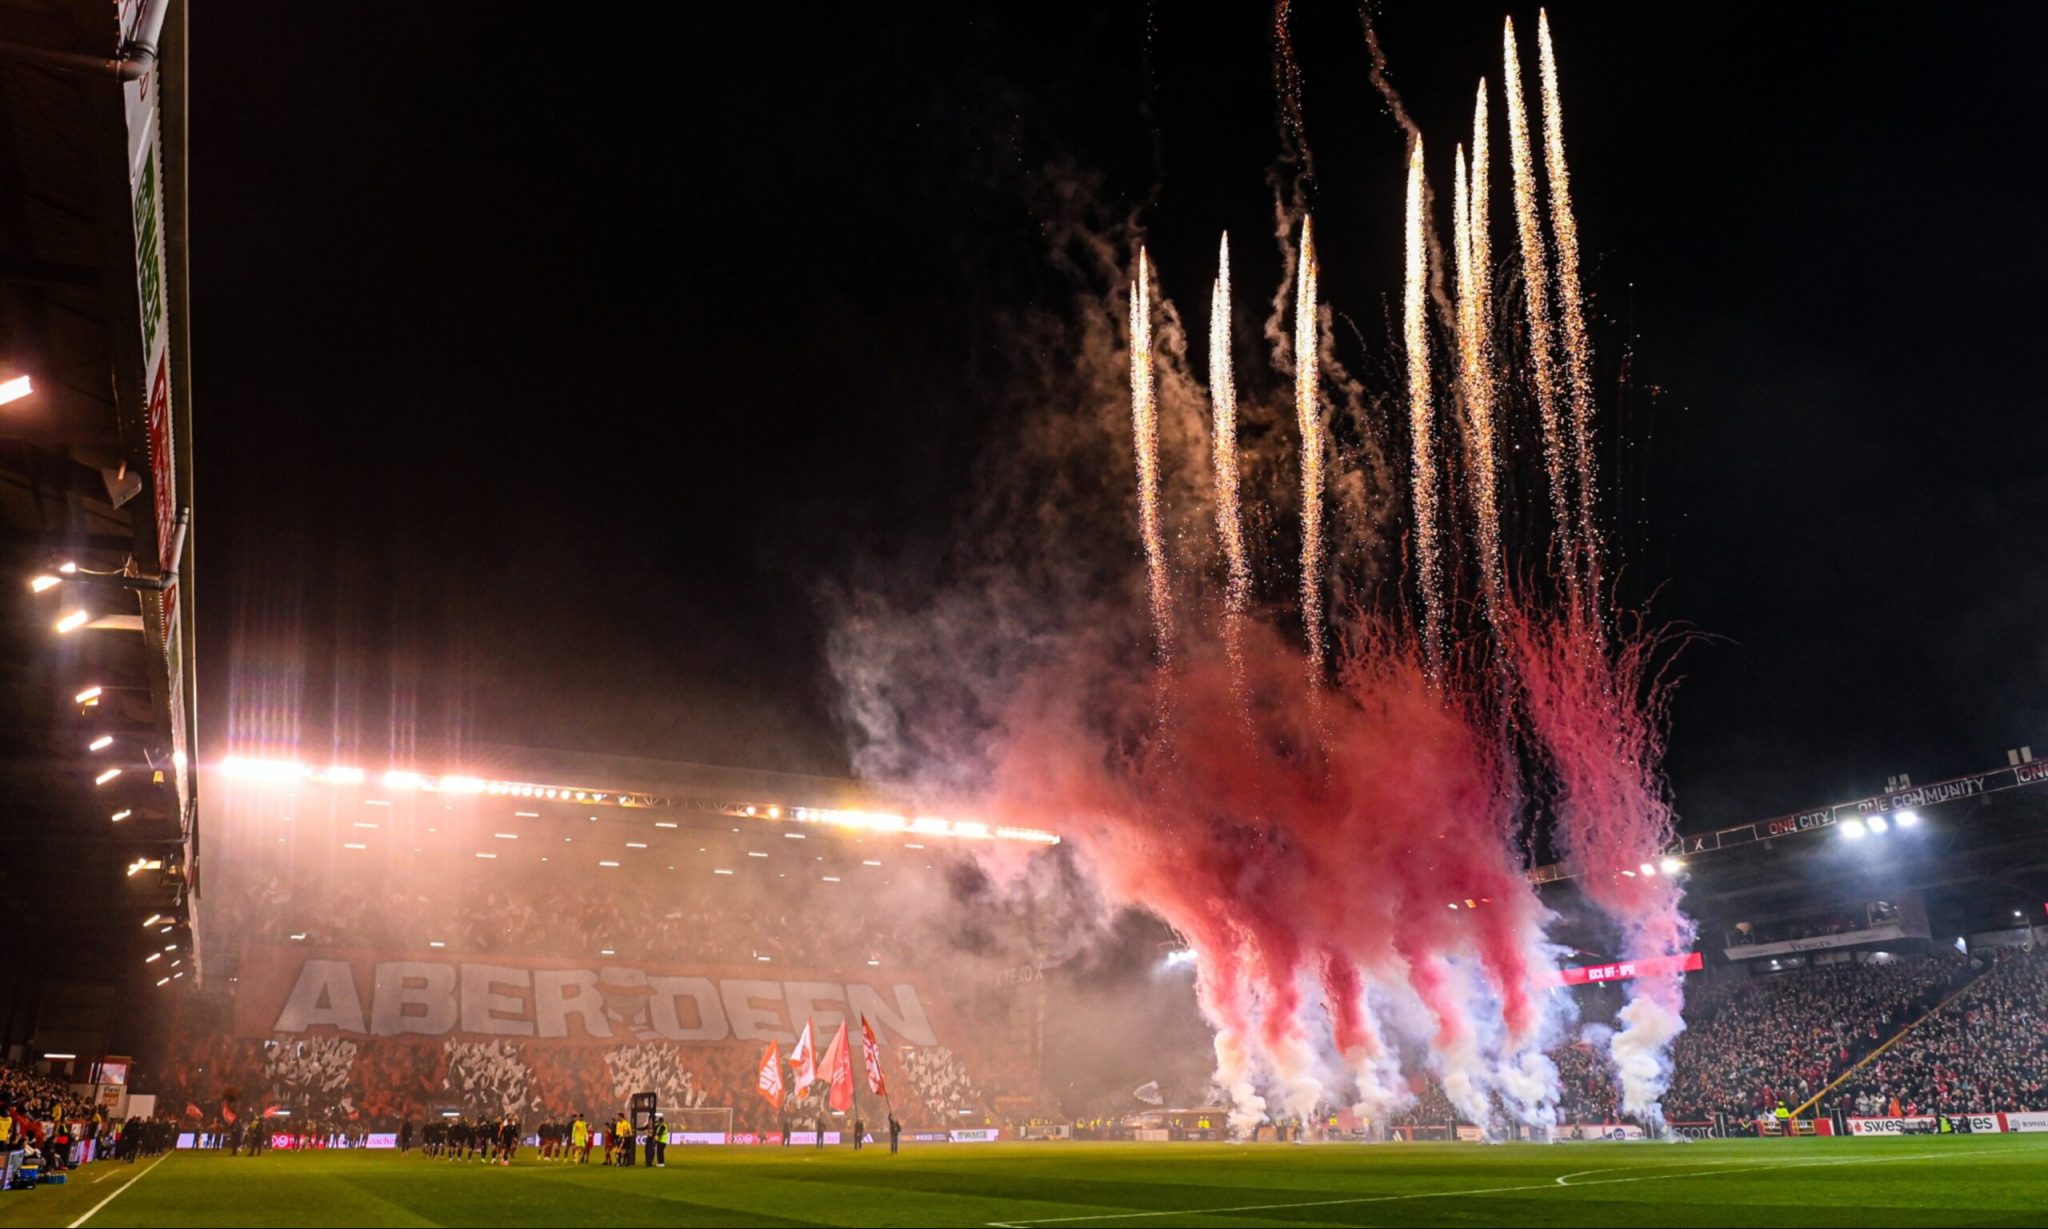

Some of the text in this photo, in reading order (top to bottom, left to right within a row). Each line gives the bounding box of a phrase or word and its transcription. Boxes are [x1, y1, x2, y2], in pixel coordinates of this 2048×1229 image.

[1892, 777, 1985, 809] COMMUNITY
[1769, 811, 1829, 835] ONE CITY
[273, 959, 938, 1046] ABERDEEN
